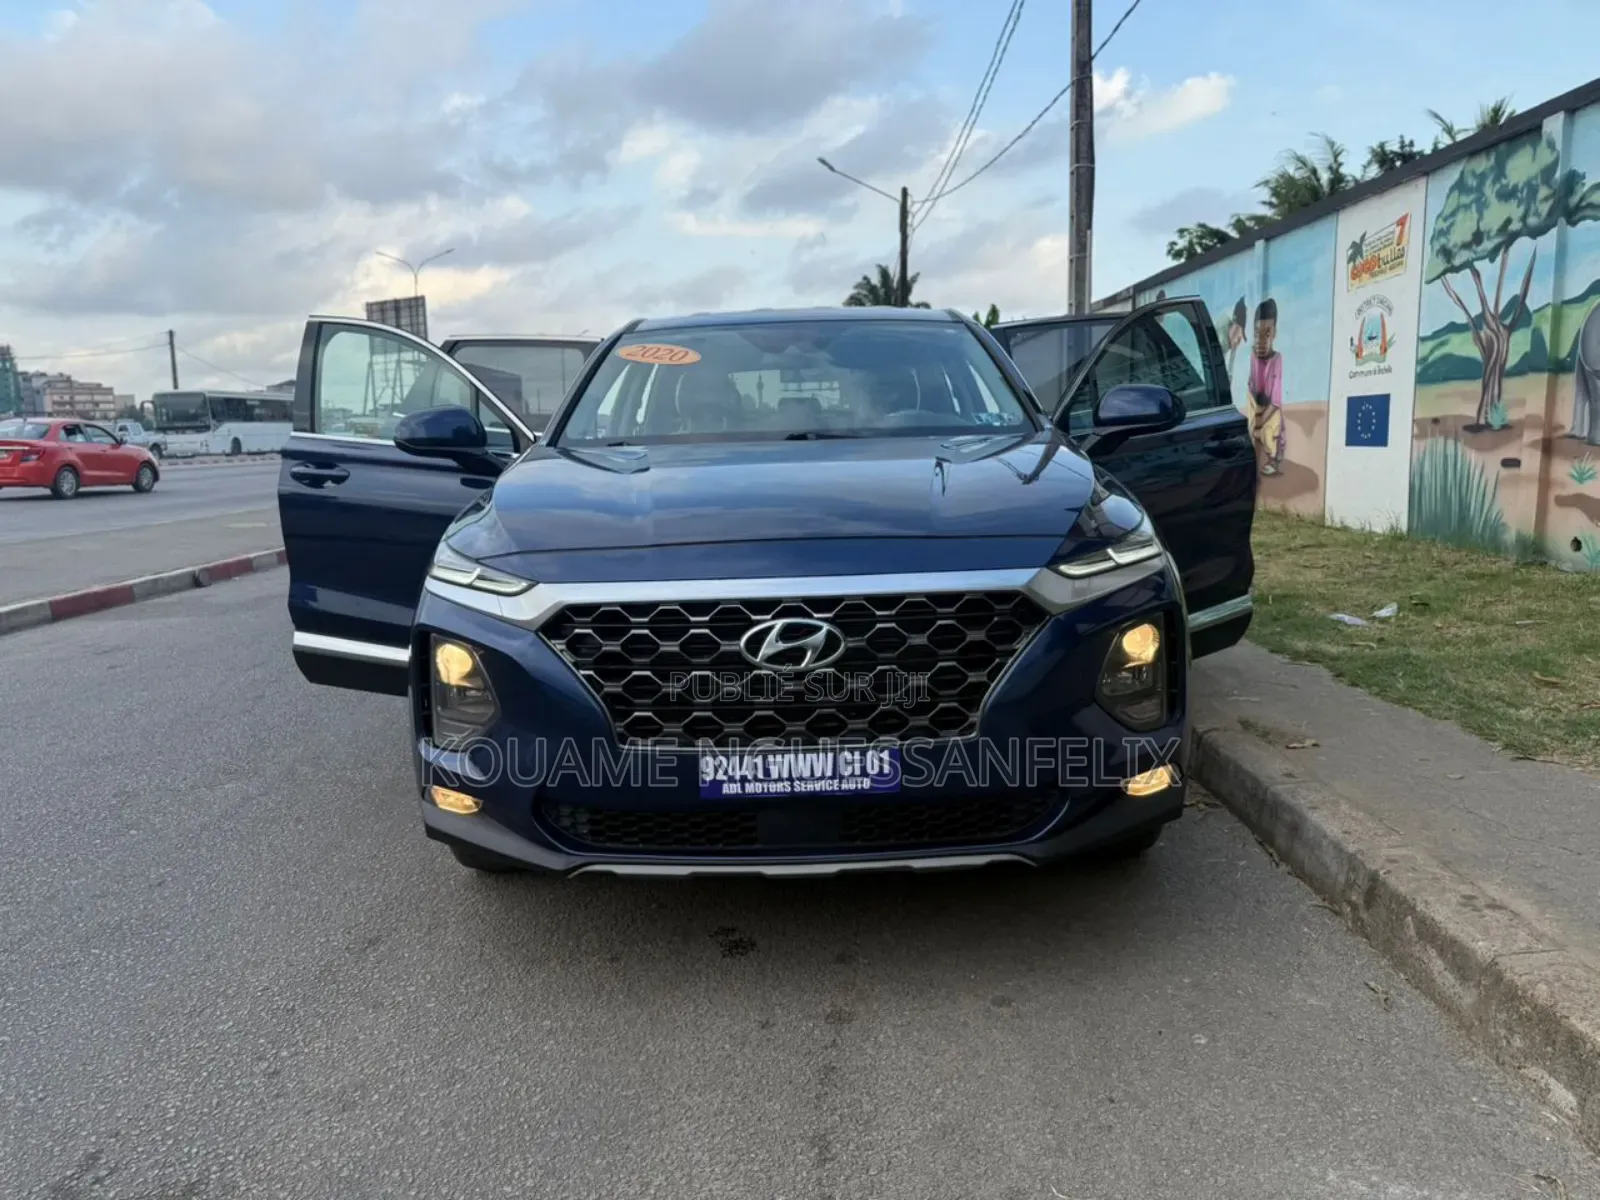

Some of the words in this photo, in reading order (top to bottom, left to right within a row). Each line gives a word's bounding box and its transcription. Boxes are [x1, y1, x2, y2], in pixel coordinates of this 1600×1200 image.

[626, 345, 689, 362] 2020
[700, 754, 764, 781] 92441
[865, 749, 890, 775] 01
[744, 781, 791, 794] MOTORS
[793, 779, 839, 793] SERVICE
[841, 777, 871, 790] AUTO
